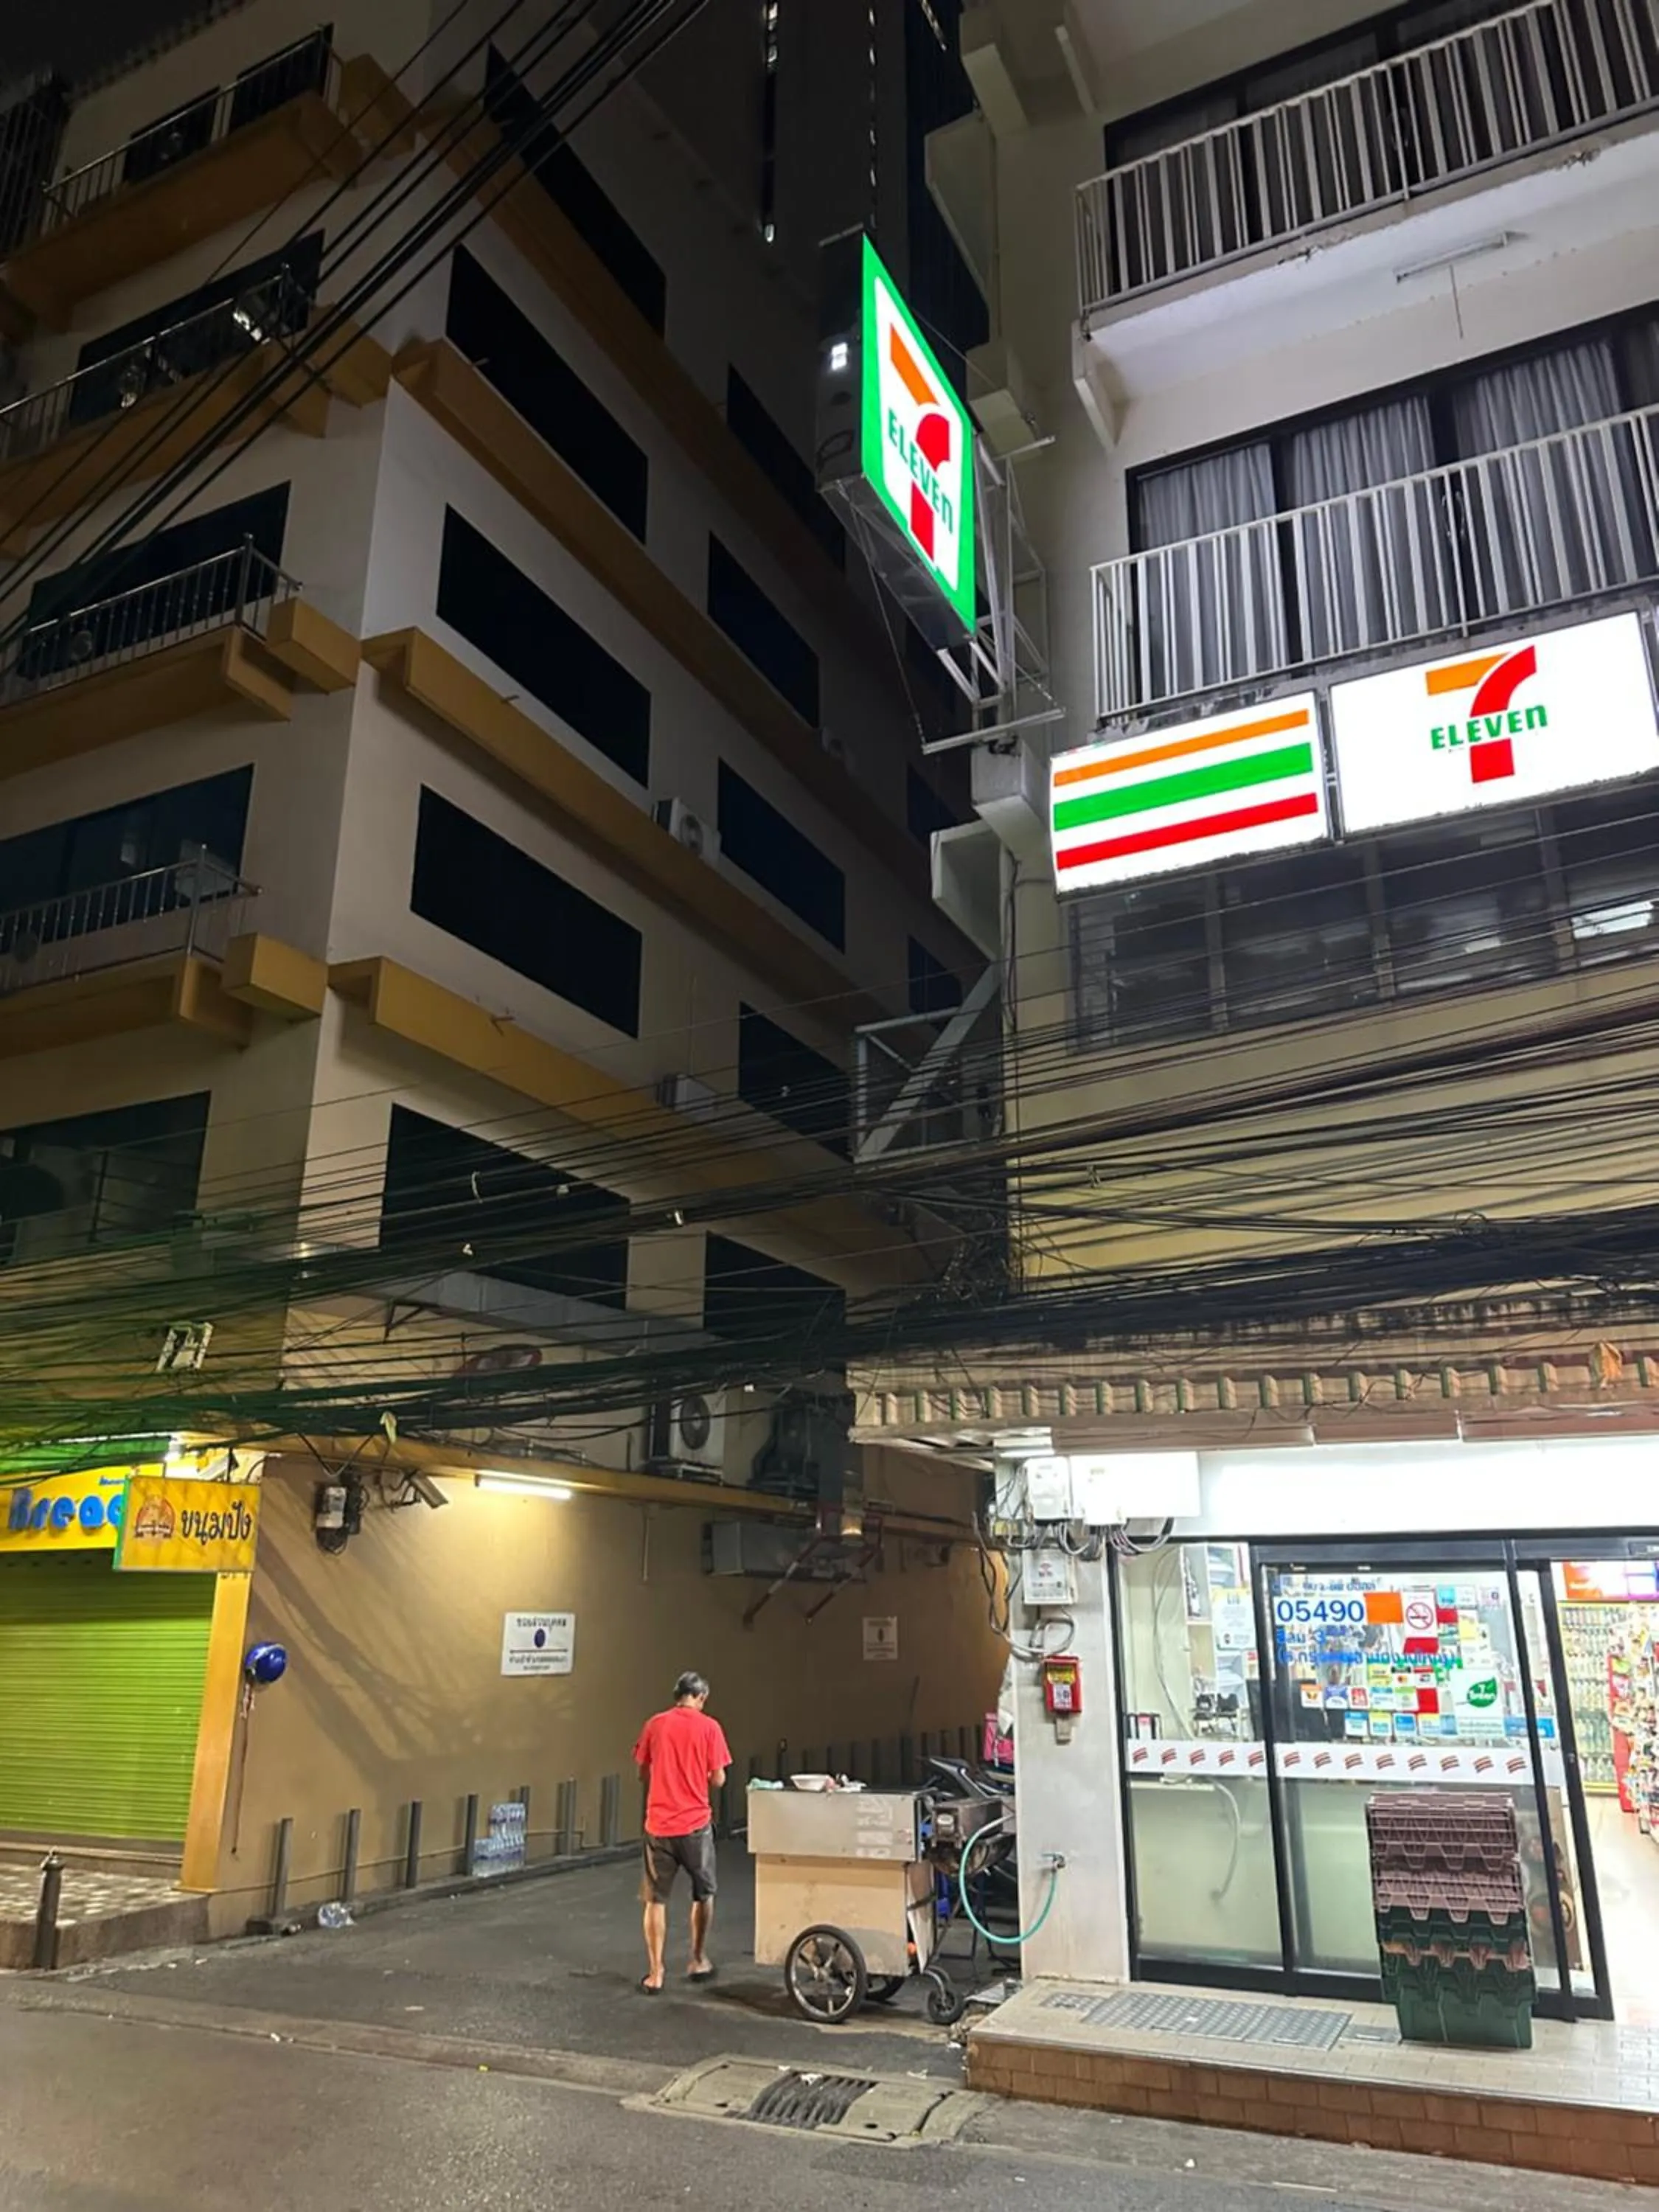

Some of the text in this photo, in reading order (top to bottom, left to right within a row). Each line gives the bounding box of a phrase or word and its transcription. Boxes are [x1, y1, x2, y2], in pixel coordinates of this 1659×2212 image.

[890, 324, 950, 561] 7
[1425, 645, 1537, 783] 7
[1276, 1600, 1365, 1623] 05490
